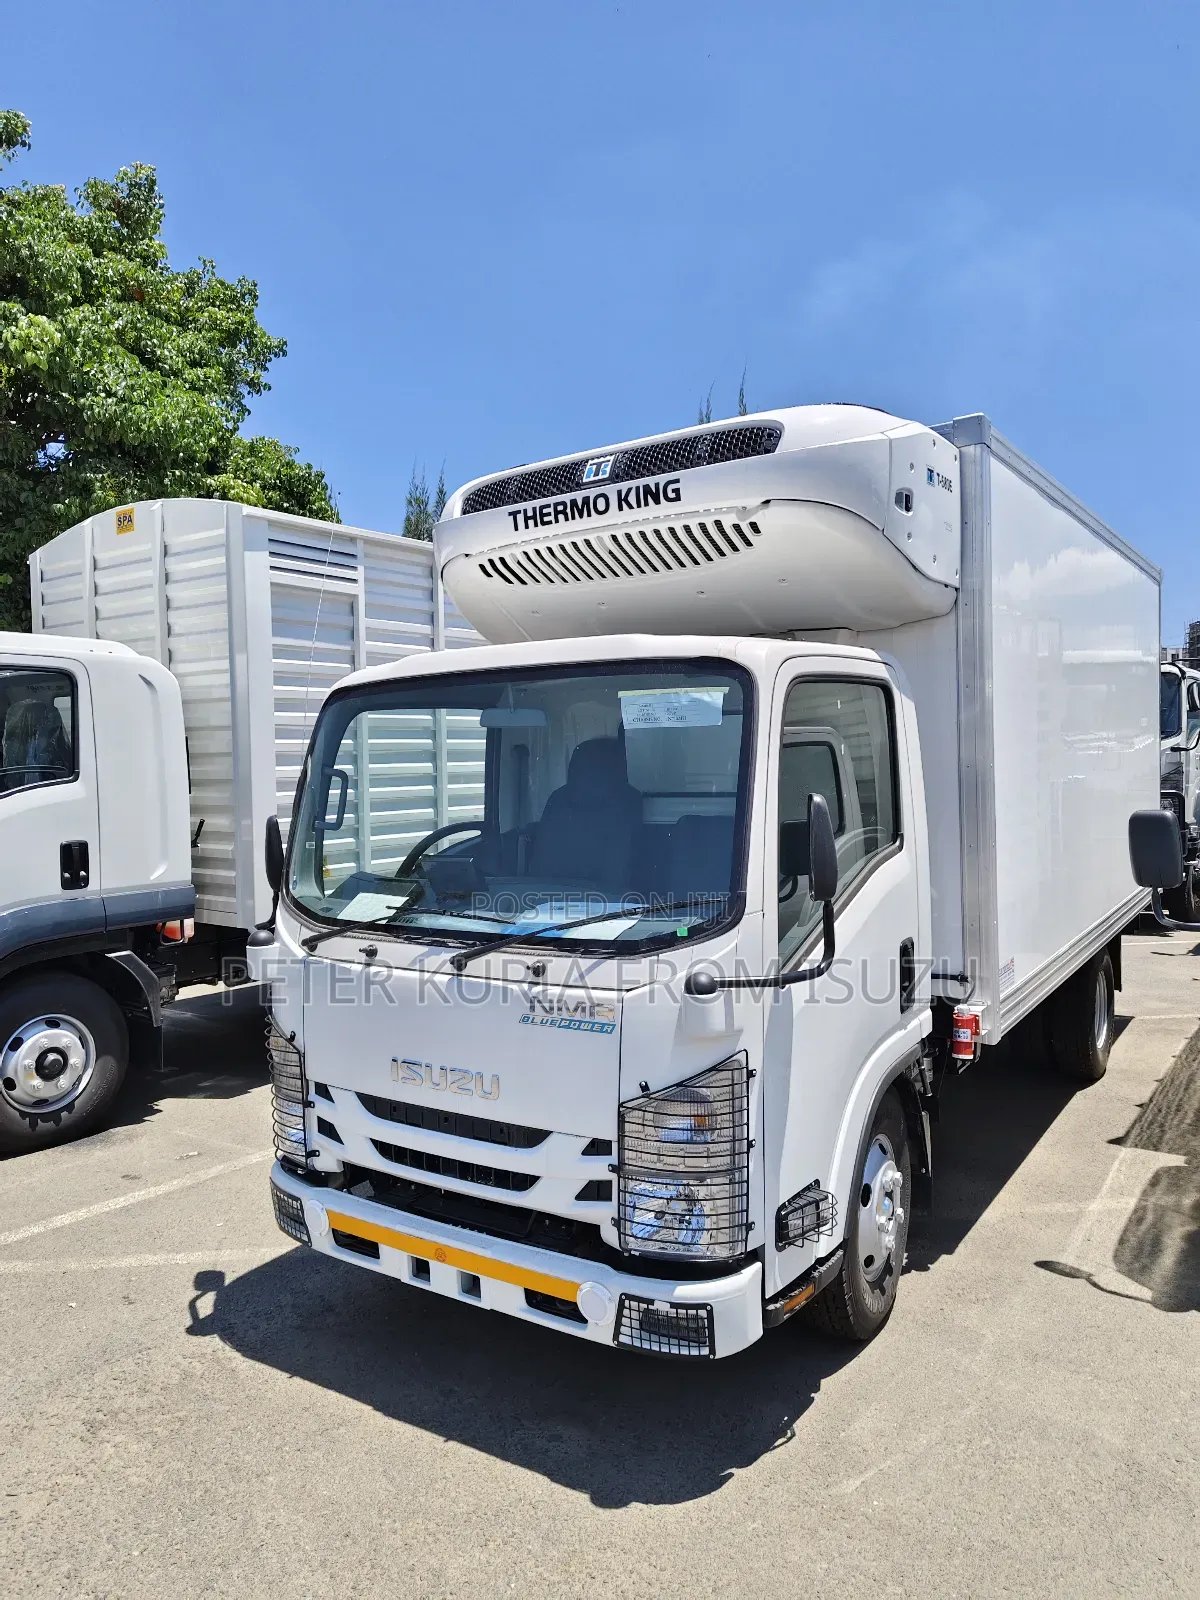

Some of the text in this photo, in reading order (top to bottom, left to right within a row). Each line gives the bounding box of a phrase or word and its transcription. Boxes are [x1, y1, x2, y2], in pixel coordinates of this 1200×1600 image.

[117, 514, 133, 527] SPA
[508, 478, 682, 532] THERMO KING
[390, 1056, 500, 1101] ISUZU
